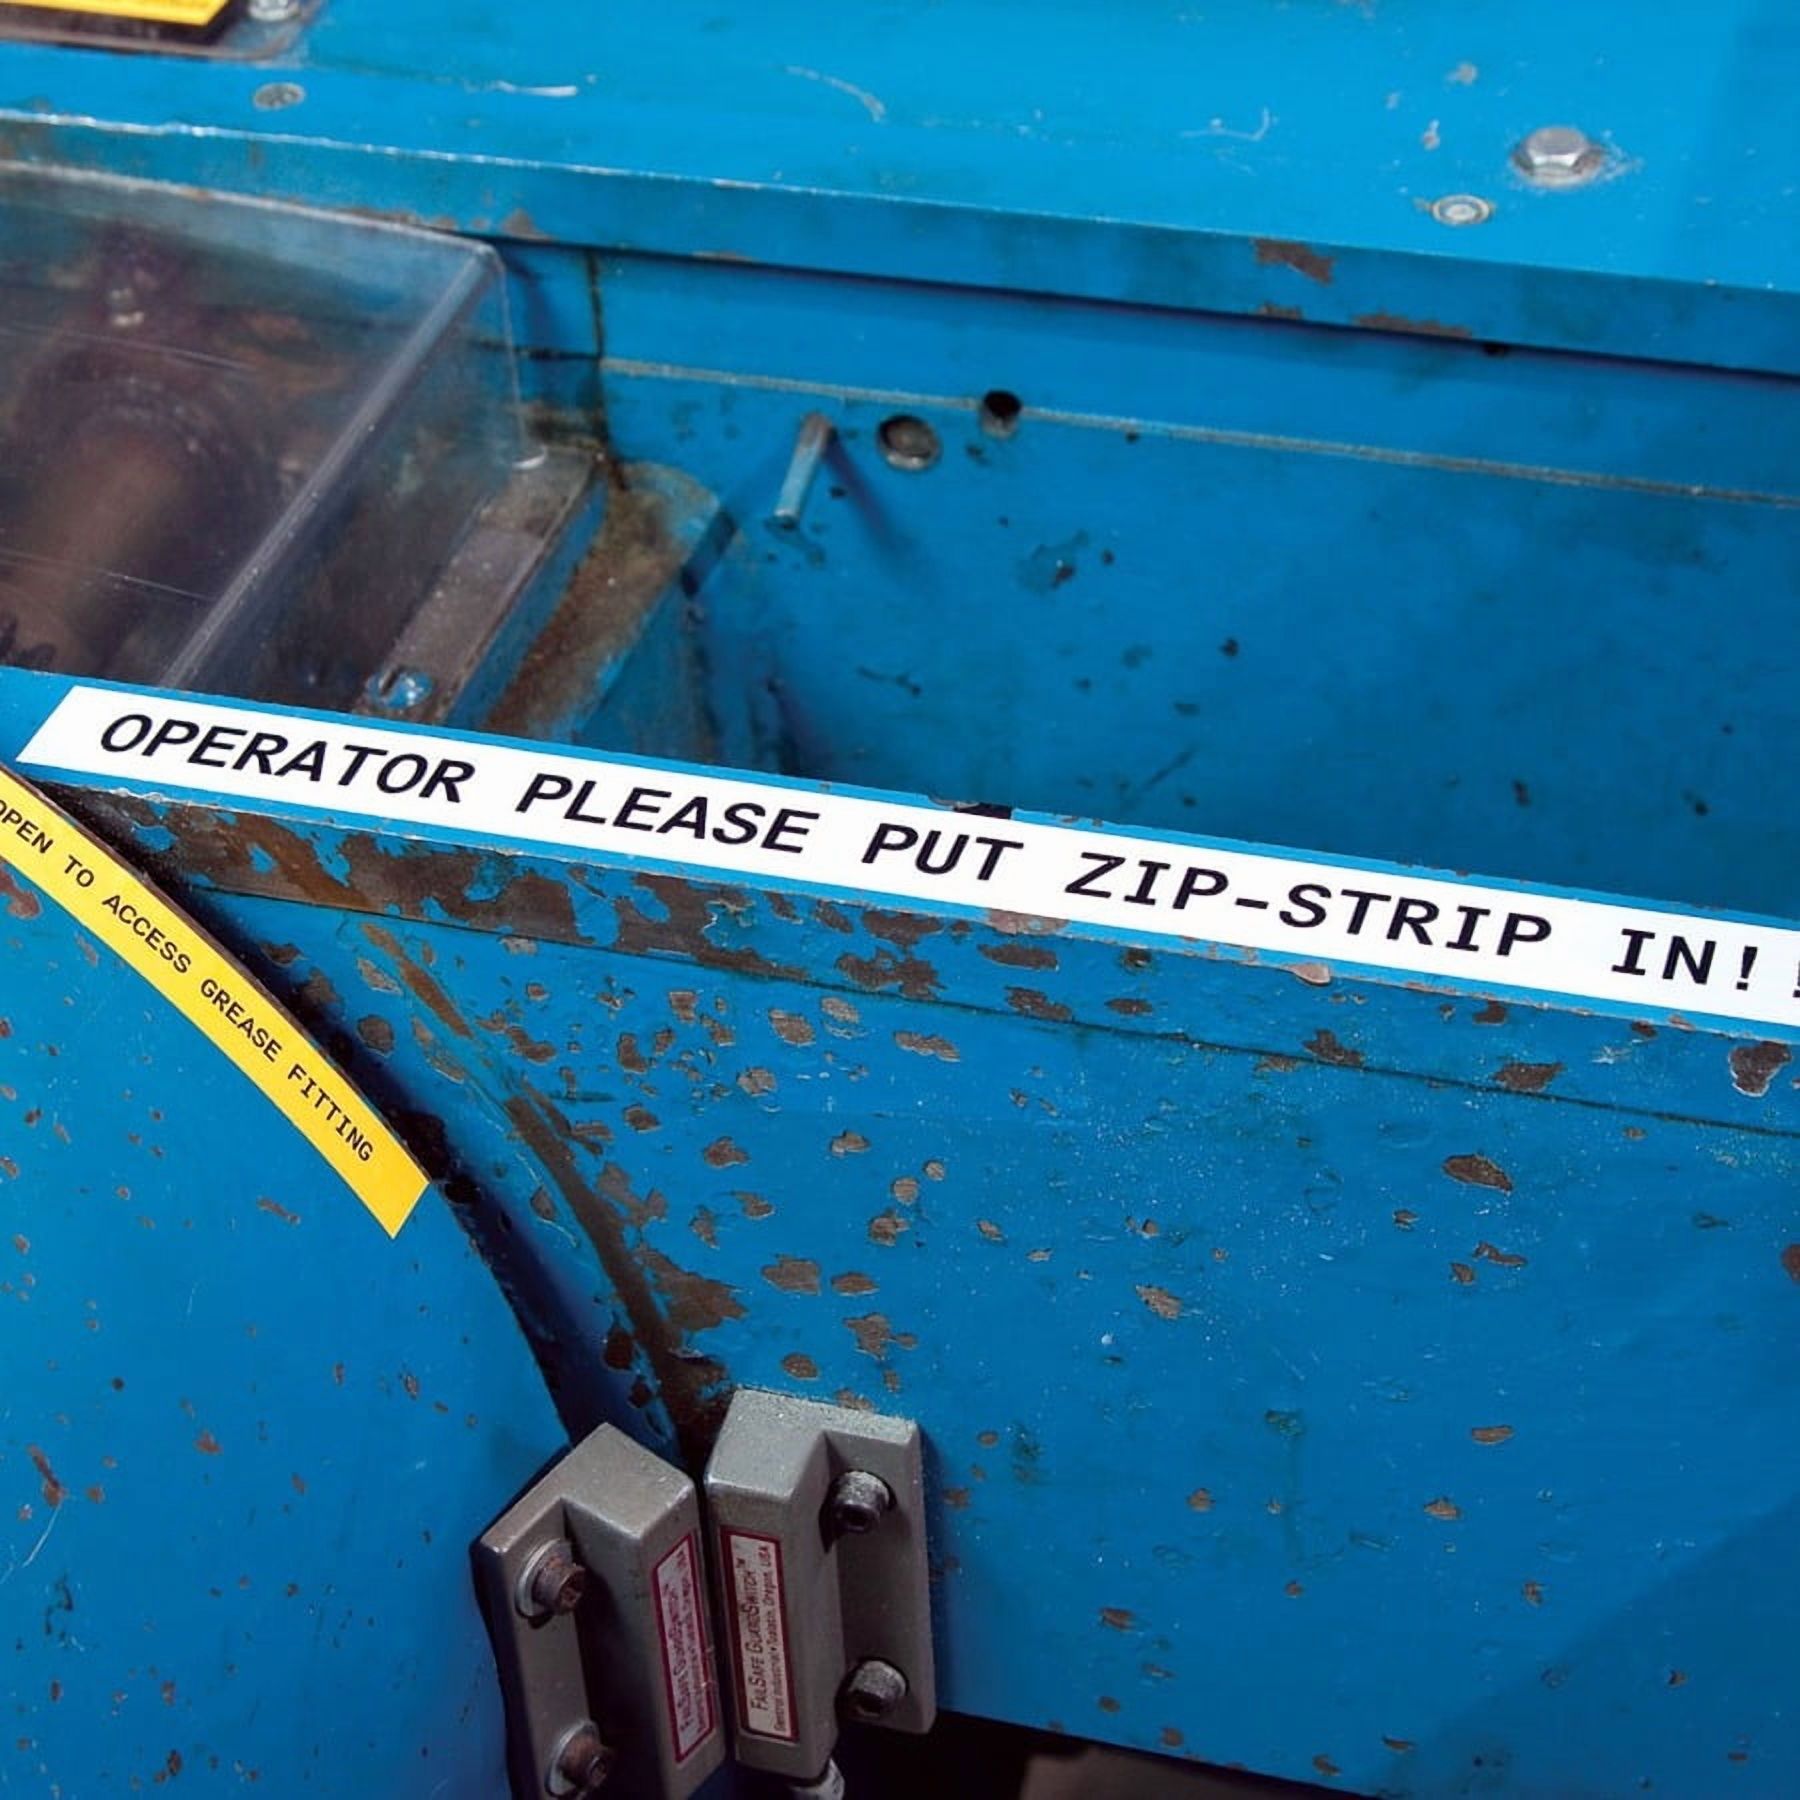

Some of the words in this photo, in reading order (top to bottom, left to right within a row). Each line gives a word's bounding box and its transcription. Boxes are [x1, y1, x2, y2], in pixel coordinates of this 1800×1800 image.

[101, 715, 475, 803] OPERATOR
[516, 774, 819, 853] PLEASE
[862, 823, 1023, 880] PUT
[1065, 852, 1551, 956] ZIP-STRIP
[65, 856, 94, 887] TO
[102, 896, 190, 973] ACCESS
[201, 980, 281, 1062] GREASE
[288, 1064, 372, 1161] FITTING
